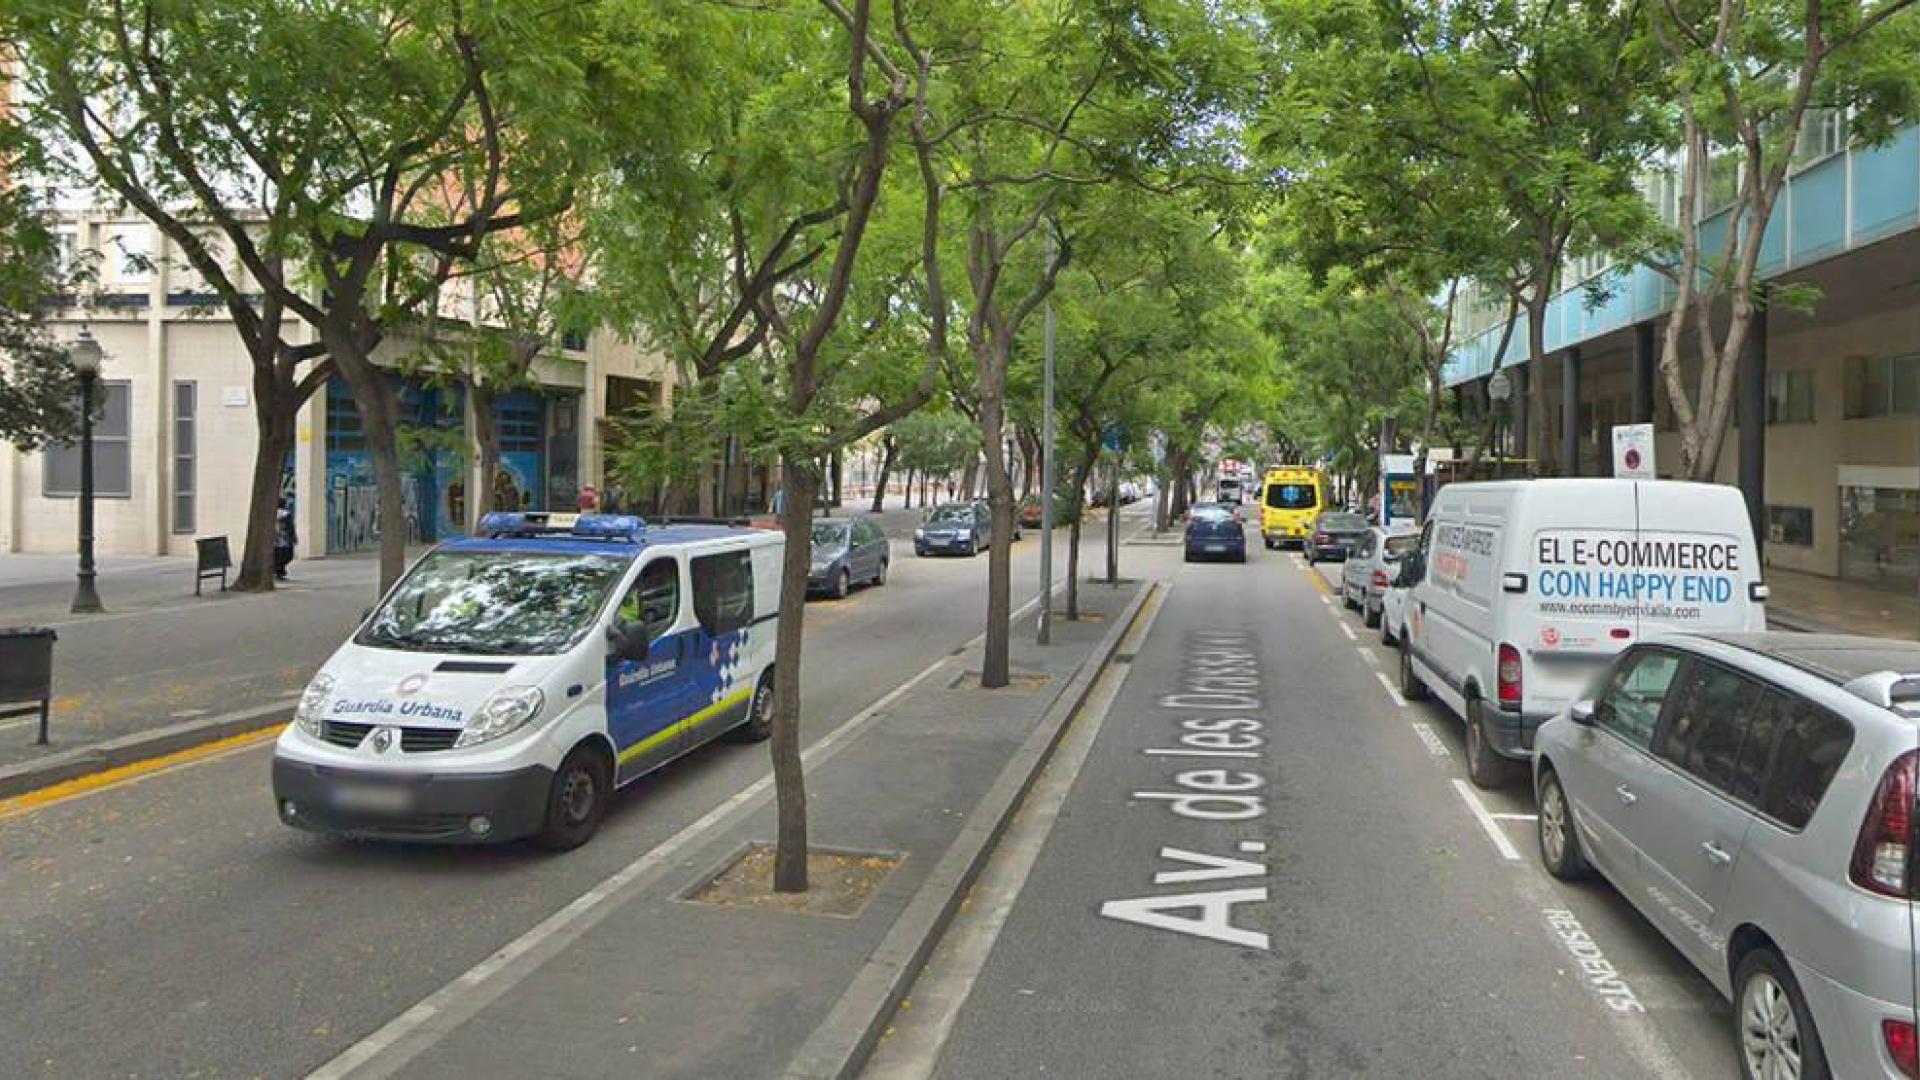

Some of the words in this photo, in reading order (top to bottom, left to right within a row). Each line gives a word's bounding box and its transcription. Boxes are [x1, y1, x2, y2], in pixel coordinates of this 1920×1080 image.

[1539, 538, 1565, 565] EL
[1573, 538, 1739, 571] E-COMMERCE
[1540, 569, 1591, 598] CON
[1599, 571, 1677, 601] HAPPY
[1683, 575, 1732, 604] END
[332, 700, 394, 714] Guardia
[400, 701, 463, 721] Urbana
[1543, 907, 1646, 1013] RESIDENTS
